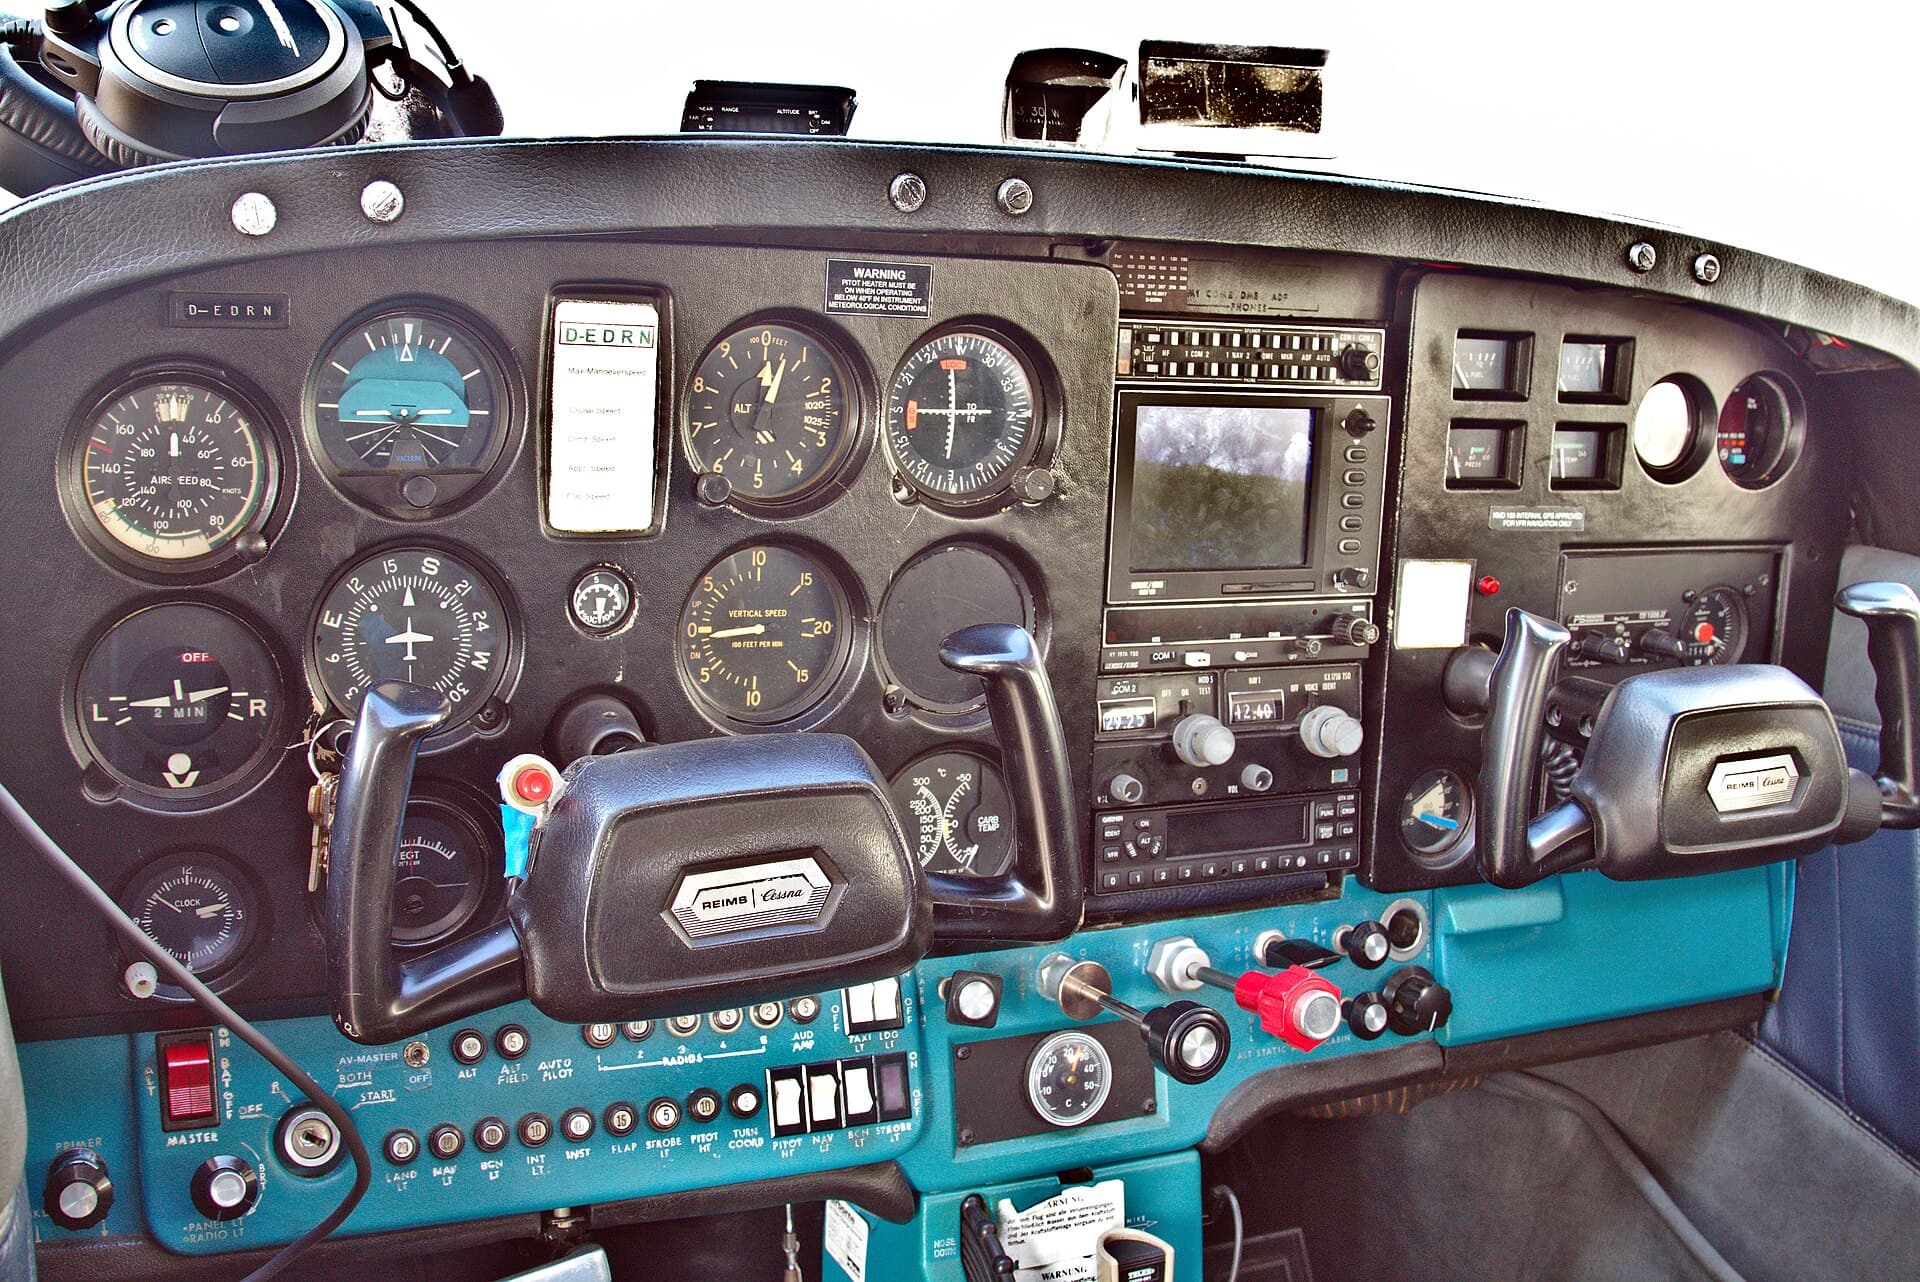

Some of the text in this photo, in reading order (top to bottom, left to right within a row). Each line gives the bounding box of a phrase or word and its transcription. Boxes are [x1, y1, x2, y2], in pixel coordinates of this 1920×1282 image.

[1031, 107, 1045, 117] 30
[854, 267, 906, 281] WARNING
[862, 280, 888, 288] HEATER
[876, 289, 913, 297] OPERATING
[828, 301, 927, 312] METEOROLOGICAL CONDITIONS
[565, 328, 652, 344] D-EDRN
[761, 330, 771, 346] 0
[772, 337, 788, 346] FEET
[923, 351, 939, 364] 24
[1191, 350, 1203, 358] COM
[982, 354, 996, 368] 30
[1001, 378, 1013, 392] 33
[734, 403, 752, 414] ALT
[805, 401, 824, 410] 1020
[804, 415, 823, 425] 1025
[116, 424, 134, 435] 160
[231, 457, 246, 467] 60
[917, 459, 930, 473] 12
[101, 463, 121, 474] 140
[209, 516, 224, 526] 80
[752, 551, 766, 566] 10
[383, 559, 398, 575] 15
[800, 572, 813, 586] 15
[454, 579, 473, 597] 21
[583, 610, 615, 624] SUCTION
[729, 610, 763, 618] VERTICAL
[472, 610, 490, 633] 24
[813, 621, 832, 635] 20
[182, 653, 210, 663] OFF
[1153, 652, 1171, 661] COM
[1131, 685, 1137, 693] 2
[1199, 687, 1211, 695] TEST
[746, 691, 761, 707] 10
[154, 706, 205, 719] 2 MIN
[912, 777, 931, 786] 300
[1727, 782, 1755, 790] REIMS
[978, 816, 999, 824] CARB
[978, 823, 1000, 833] TEMP
[400, 851, 420, 861] EGT
[182, 866, 193, 875] 12
[1238, 864, 1244, 872] 5
[174, 899, 201, 907] CLOCK
[702, 888, 805, 910] REIMS Cessna
[904, 998, 913, 1024] OFF
[831, 1005, 840, 1033] OFF
[596, 1025, 609, 1037] 10
[792, 1031, 814, 1041] AUD
[879, 1031, 899, 1041] LDG
[848, 1034, 872, 1044] TAXI
[792, 1040, 815, 1052] AMP
[1256, 1046, 1287, 1058] STATIC
[338, 1052, 398, 1066] AV-MASTER
[662, 1053, 704, 1067] RADIOS
[538, 1058, 572, 1072] AUTO
[1084, 1064, 1095, 1073] 40
[339, 1071, 372, 1083] BOTH
[409, 1074, 430, 1085] OFF
[457, 1070, 478, 1080] ALT
[497, 1073, 529, 1085] FIELD
[542, 1068, 574, 1082] PILOT
[1084, 1081, 1095, 1090] 50
[360, 1089, 395, 1102] START
[239, 1104, 264, 1114] OFF
[733, 1128, 758, 1138] TURN
[848, 1129, 869, 1139] BCN
[876, 1123, 912, 1135] STROBE
[166, 1133, 219, 1147] MASTER
[690, 1132, 719, 1145] PITOT
[728, 1138, 765, 1150] COORD
[812, 1134, 834, 1145] NAV
[612, 1143, 638, 1154] FLAP
[645, 1139, 682, 1150] STROBE
[772, 1138, 803, 1151] PITOT
[527, 1154, 546, 1165] INT
[565, 1148, 591, 1161] INST
[480, 1160, 504, 1171] BCN
[259, 1163, 267, 1191] BRT
[386, 1171, 418, 1183] LAND
[188, 1217, 245, 1232] PANEL LT
[1127, 1215, 1146, 1224] MIKE
[188, 1227, 244, 1243] RADIO LT
[934, 1238, 957, 1249] NOSE
[1042, 1265, 1088, 1282] WARNUNG
